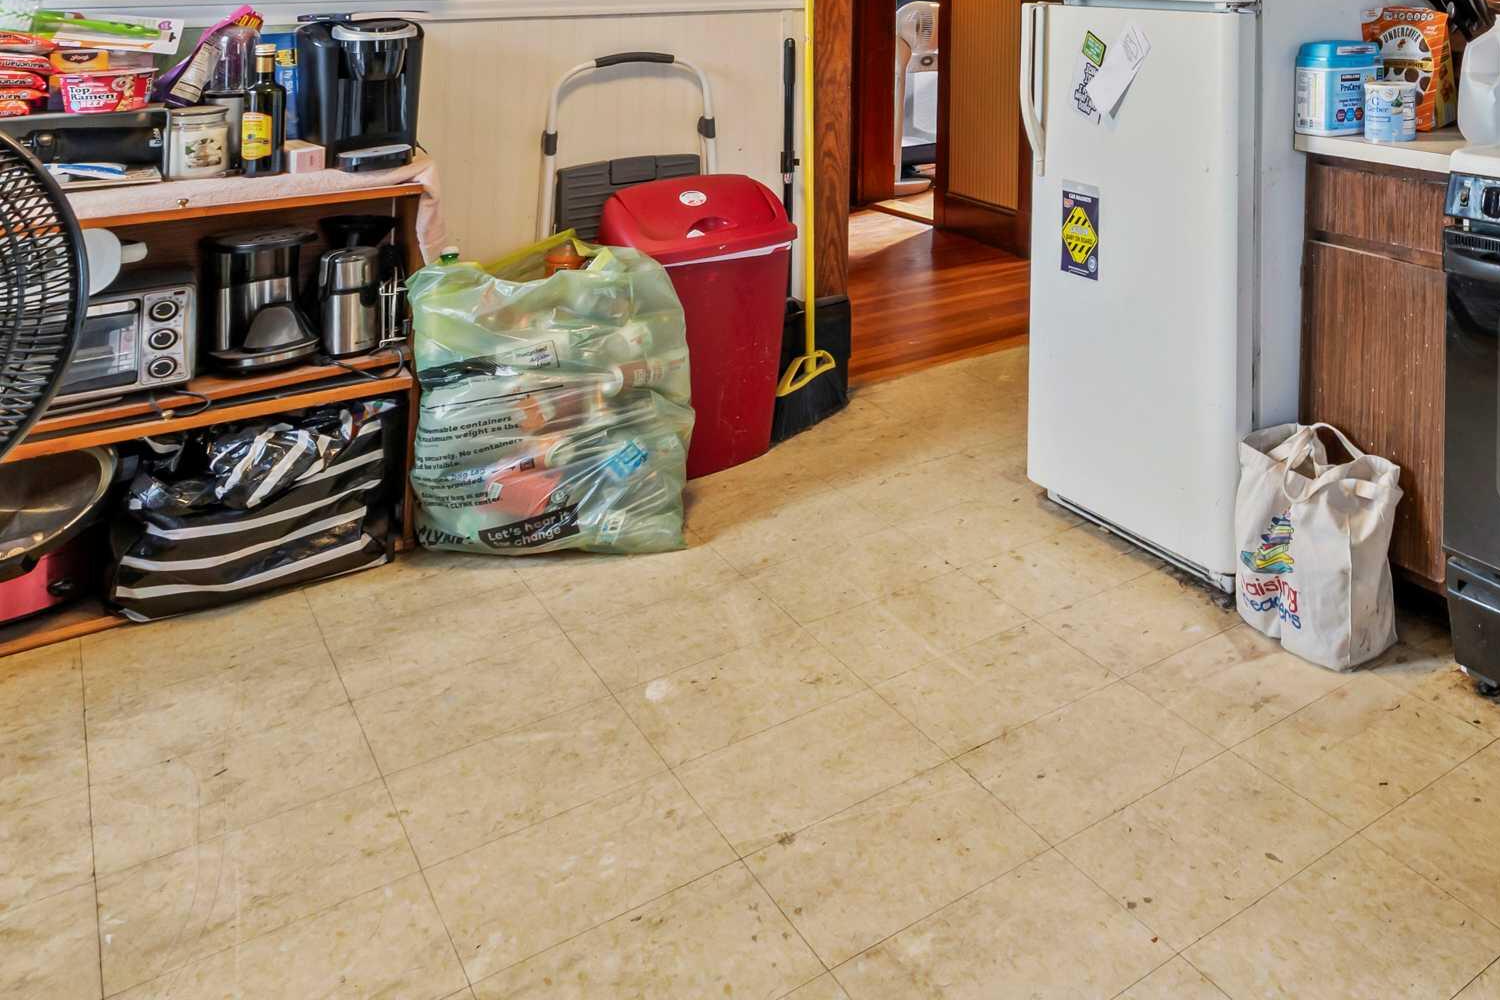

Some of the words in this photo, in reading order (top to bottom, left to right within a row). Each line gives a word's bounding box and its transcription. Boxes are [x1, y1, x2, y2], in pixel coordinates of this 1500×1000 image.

[460, 415, 512, 430] containers
[455, 427, 489, 439] weight
[487, 526, 522, 541] Let's
[513, 525, 561, 547] change
